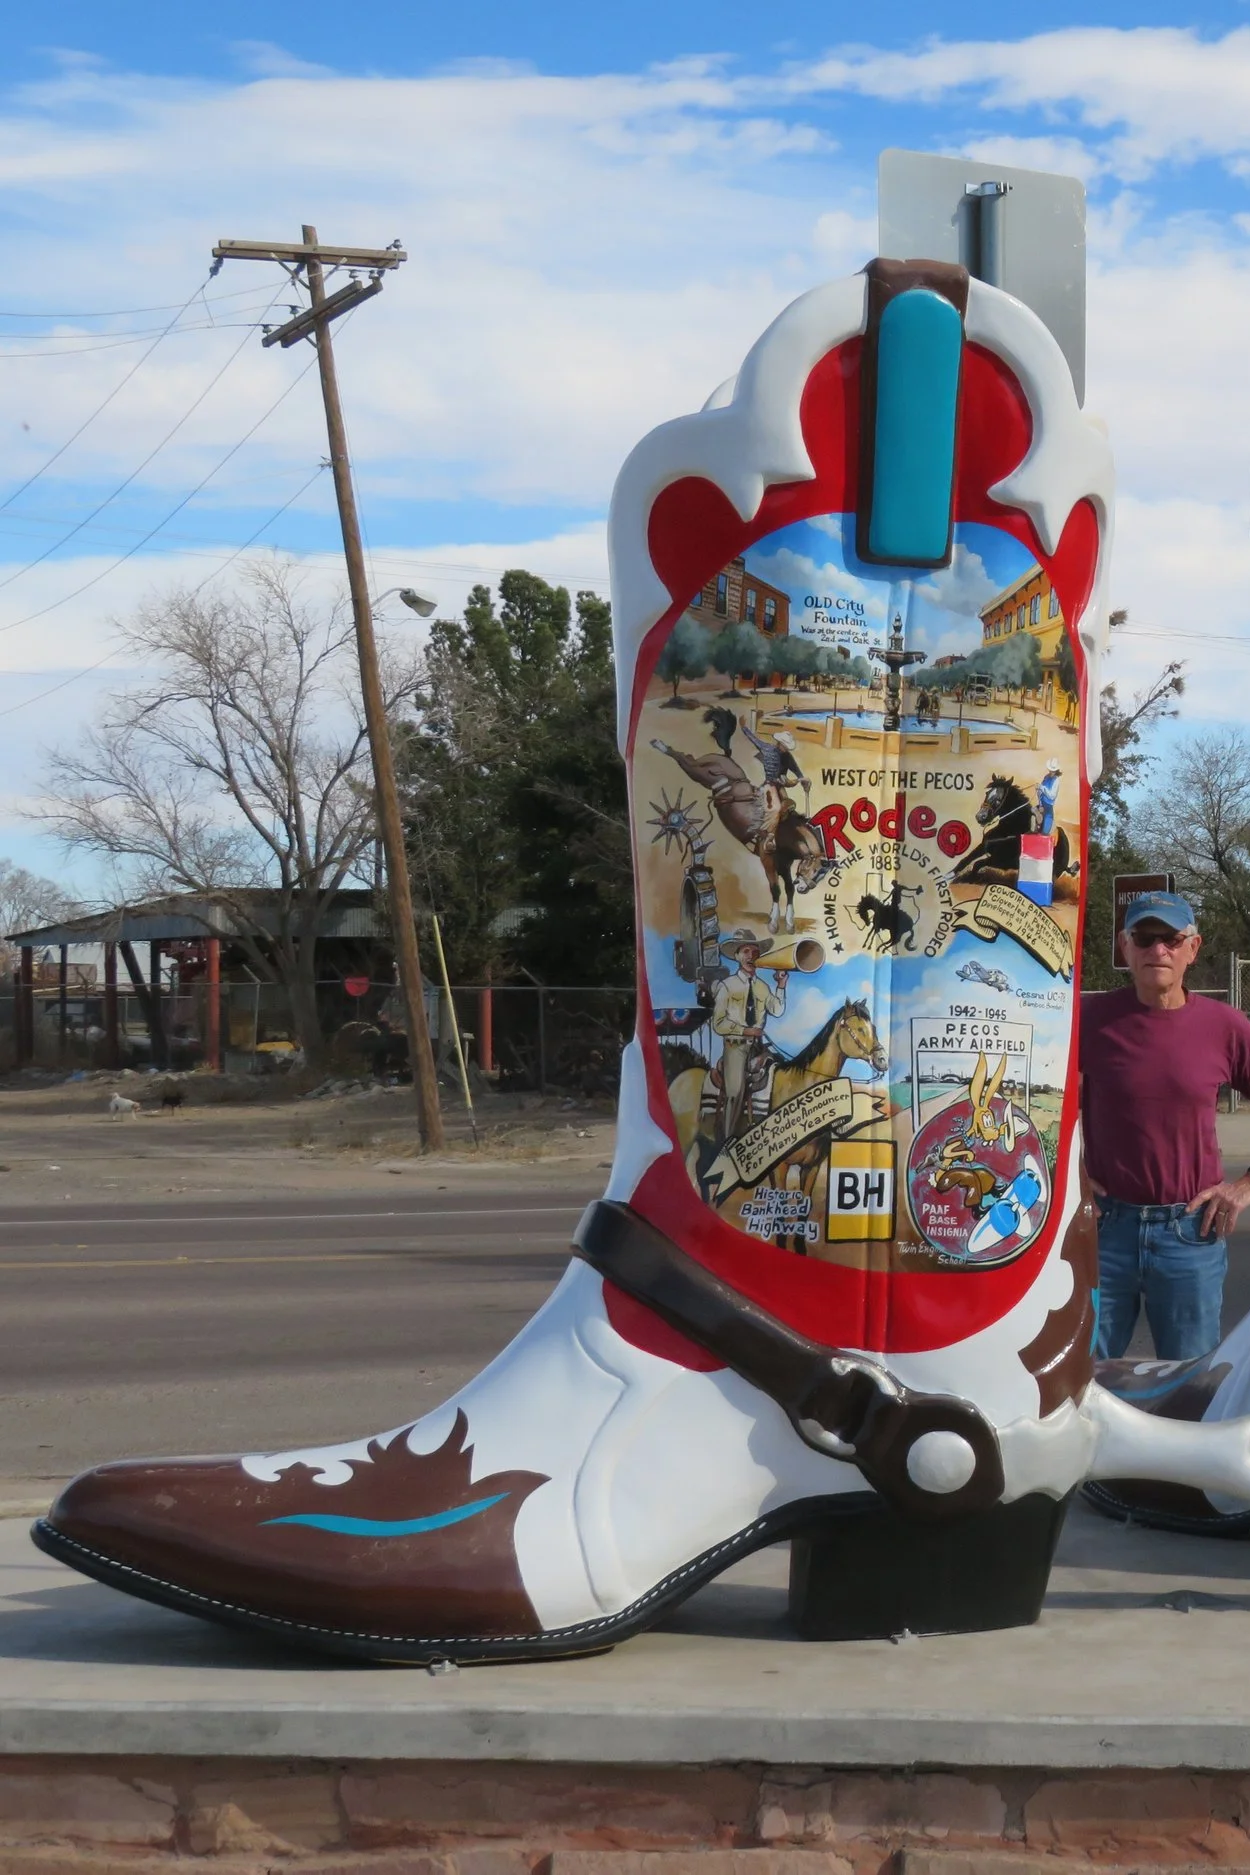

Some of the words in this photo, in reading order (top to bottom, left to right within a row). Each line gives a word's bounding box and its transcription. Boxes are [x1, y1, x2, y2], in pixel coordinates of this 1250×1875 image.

[804, 596, 832, 608] OLD
[836, 599, 865, 616] City
[814, 611, 868, 627] Fountain
[801, 625, 816, 634] Was
[825, 628, 836, 636] the
[820, 634, 836, 642] 2nd
[852, 636, 870, 644] Oak
[821, 768, 866, 786] WEST
[868, 770, 885, 787] OF
[890, 771, 918, 788] THE
[924, 772, 975, 791] PECOS
[810, 791, 971, 860] Rodeo
[840, 848, 864, 869] THE
[869, 842, 931, 868] WORLD'S
[870, 855, 901, 871] 1883
[828, 868, 842, 888] OF
[927, 866, 953, 907] FIRST
[824, 893, 840, 940] HOME
[981, 899, 1015, 919] Developed
[989, 885, 1026, 907] COWGIRL
[1027, 903, 1052, 929] BARREL
[924, 911, 953, 958] RODEO
[1005, 918, 1013, 927] in
[1017, 925, 1036, 945] 1946
[1016, 988, 1044, 1000] Cessna
[946, 1023, 1000, 1036] PECOS
[918, 1037, 964, 1049] ARMY
[735, 1122, 770, 1157] BUCK
[774, 1083, 833, 1124] JACKSON
[738, 1136, 771, 1167] Pecos
[770, 1116, 802, 1138] Rodeo
[801, 1093, 850, 1119] Announcer
[745, 1156, 764, 1175] for
[768, 1132, 798, 1158] Many
[801, 1108, 837, 1133] Years
[754, 1187, 803, 1201] Historic
[837, 1172, 886, 1210] BH
[741, 1199, 809, 1216] Bankhead
[922, 1203, 950, 1215] PAAF
[749, 1217, 818, 1240] Highway
[928, 1216, 958, 1225] BASE
[926, 1226, 968, 1237] INSIGNIA
[897, 1241, 917, 1254] Twin
[937, 1254, 966, 1265] School
